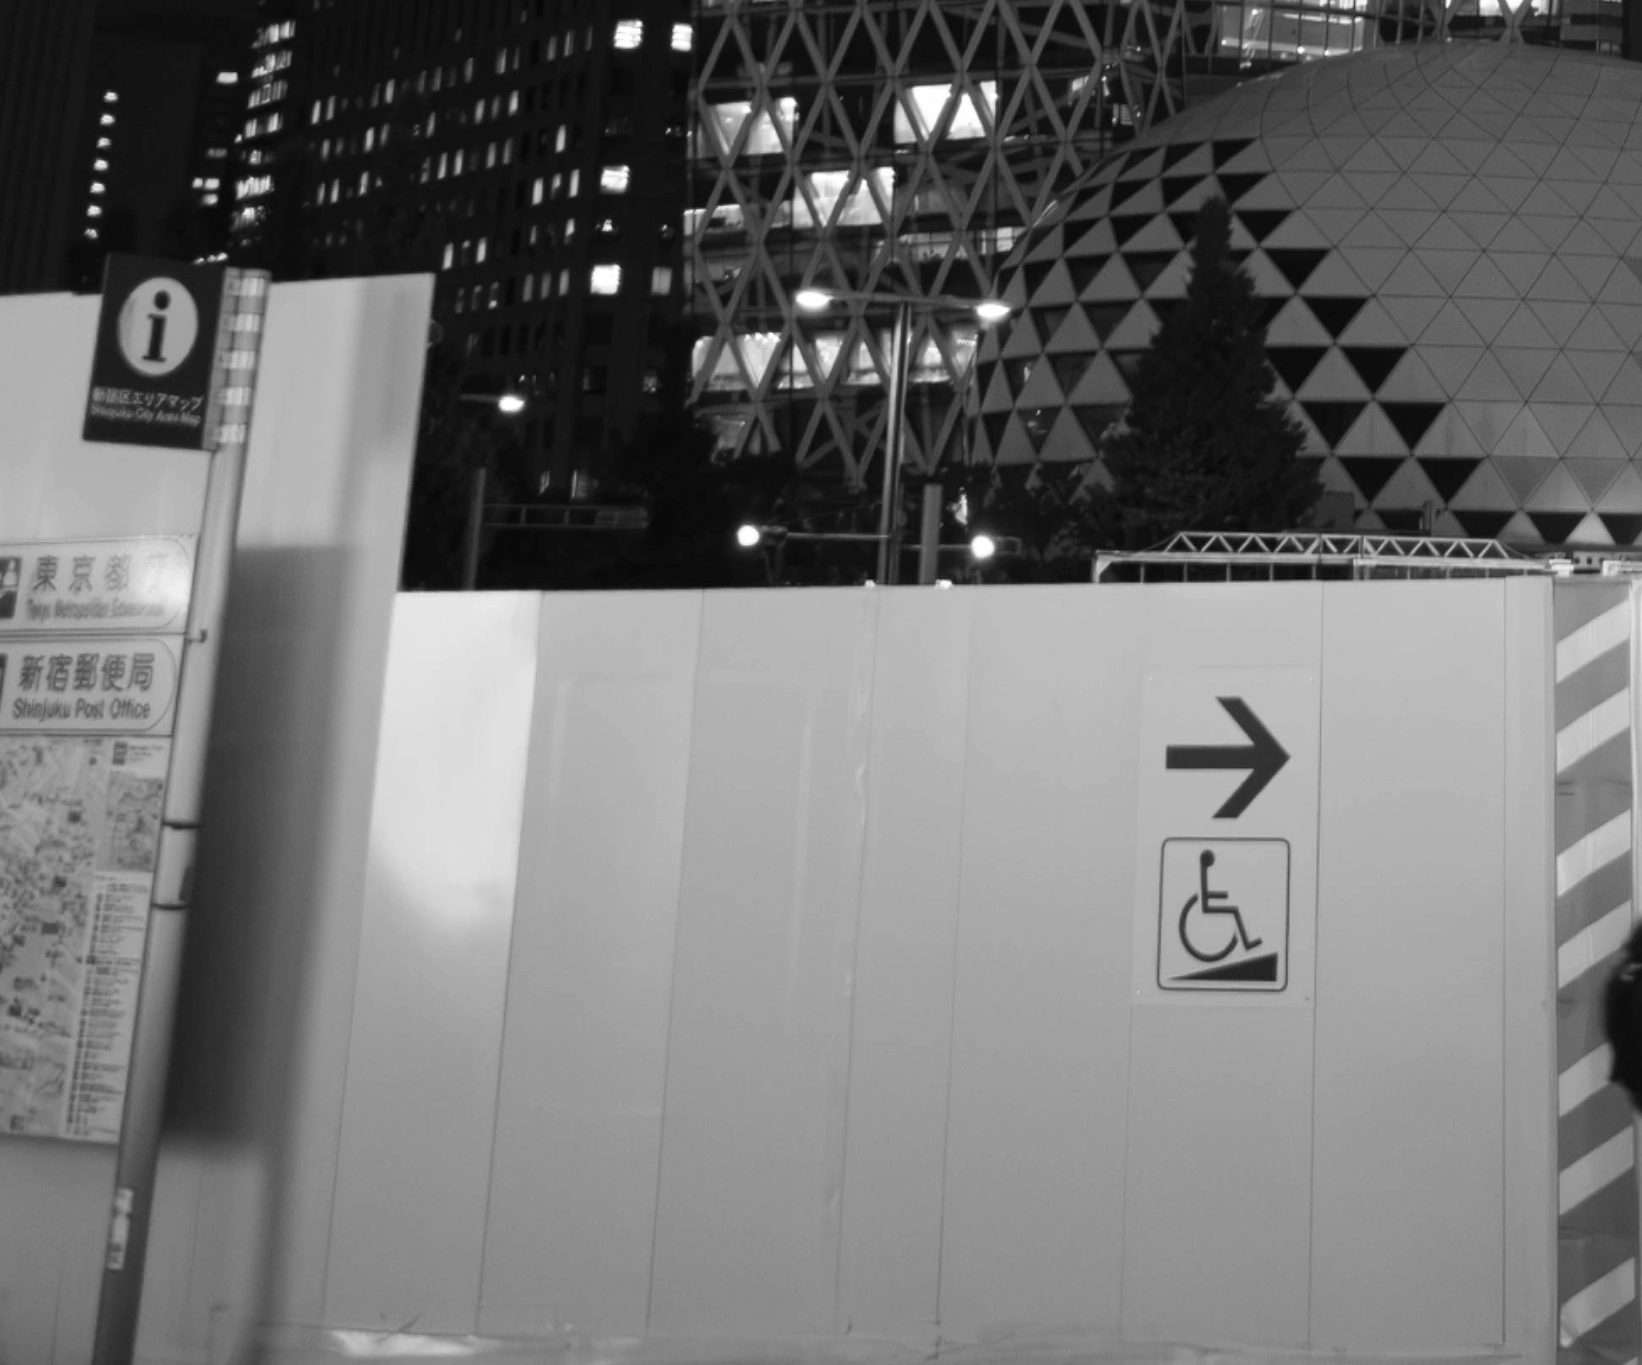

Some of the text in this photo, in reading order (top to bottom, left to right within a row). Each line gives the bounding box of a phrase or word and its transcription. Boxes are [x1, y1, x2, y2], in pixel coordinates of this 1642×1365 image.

[92, 385, 205, 413] 新宿区エリアマップ
[18, 652, 156, 693] 新宿郵便局
[12, 697, 151, 722] Shinjuku Post Office
